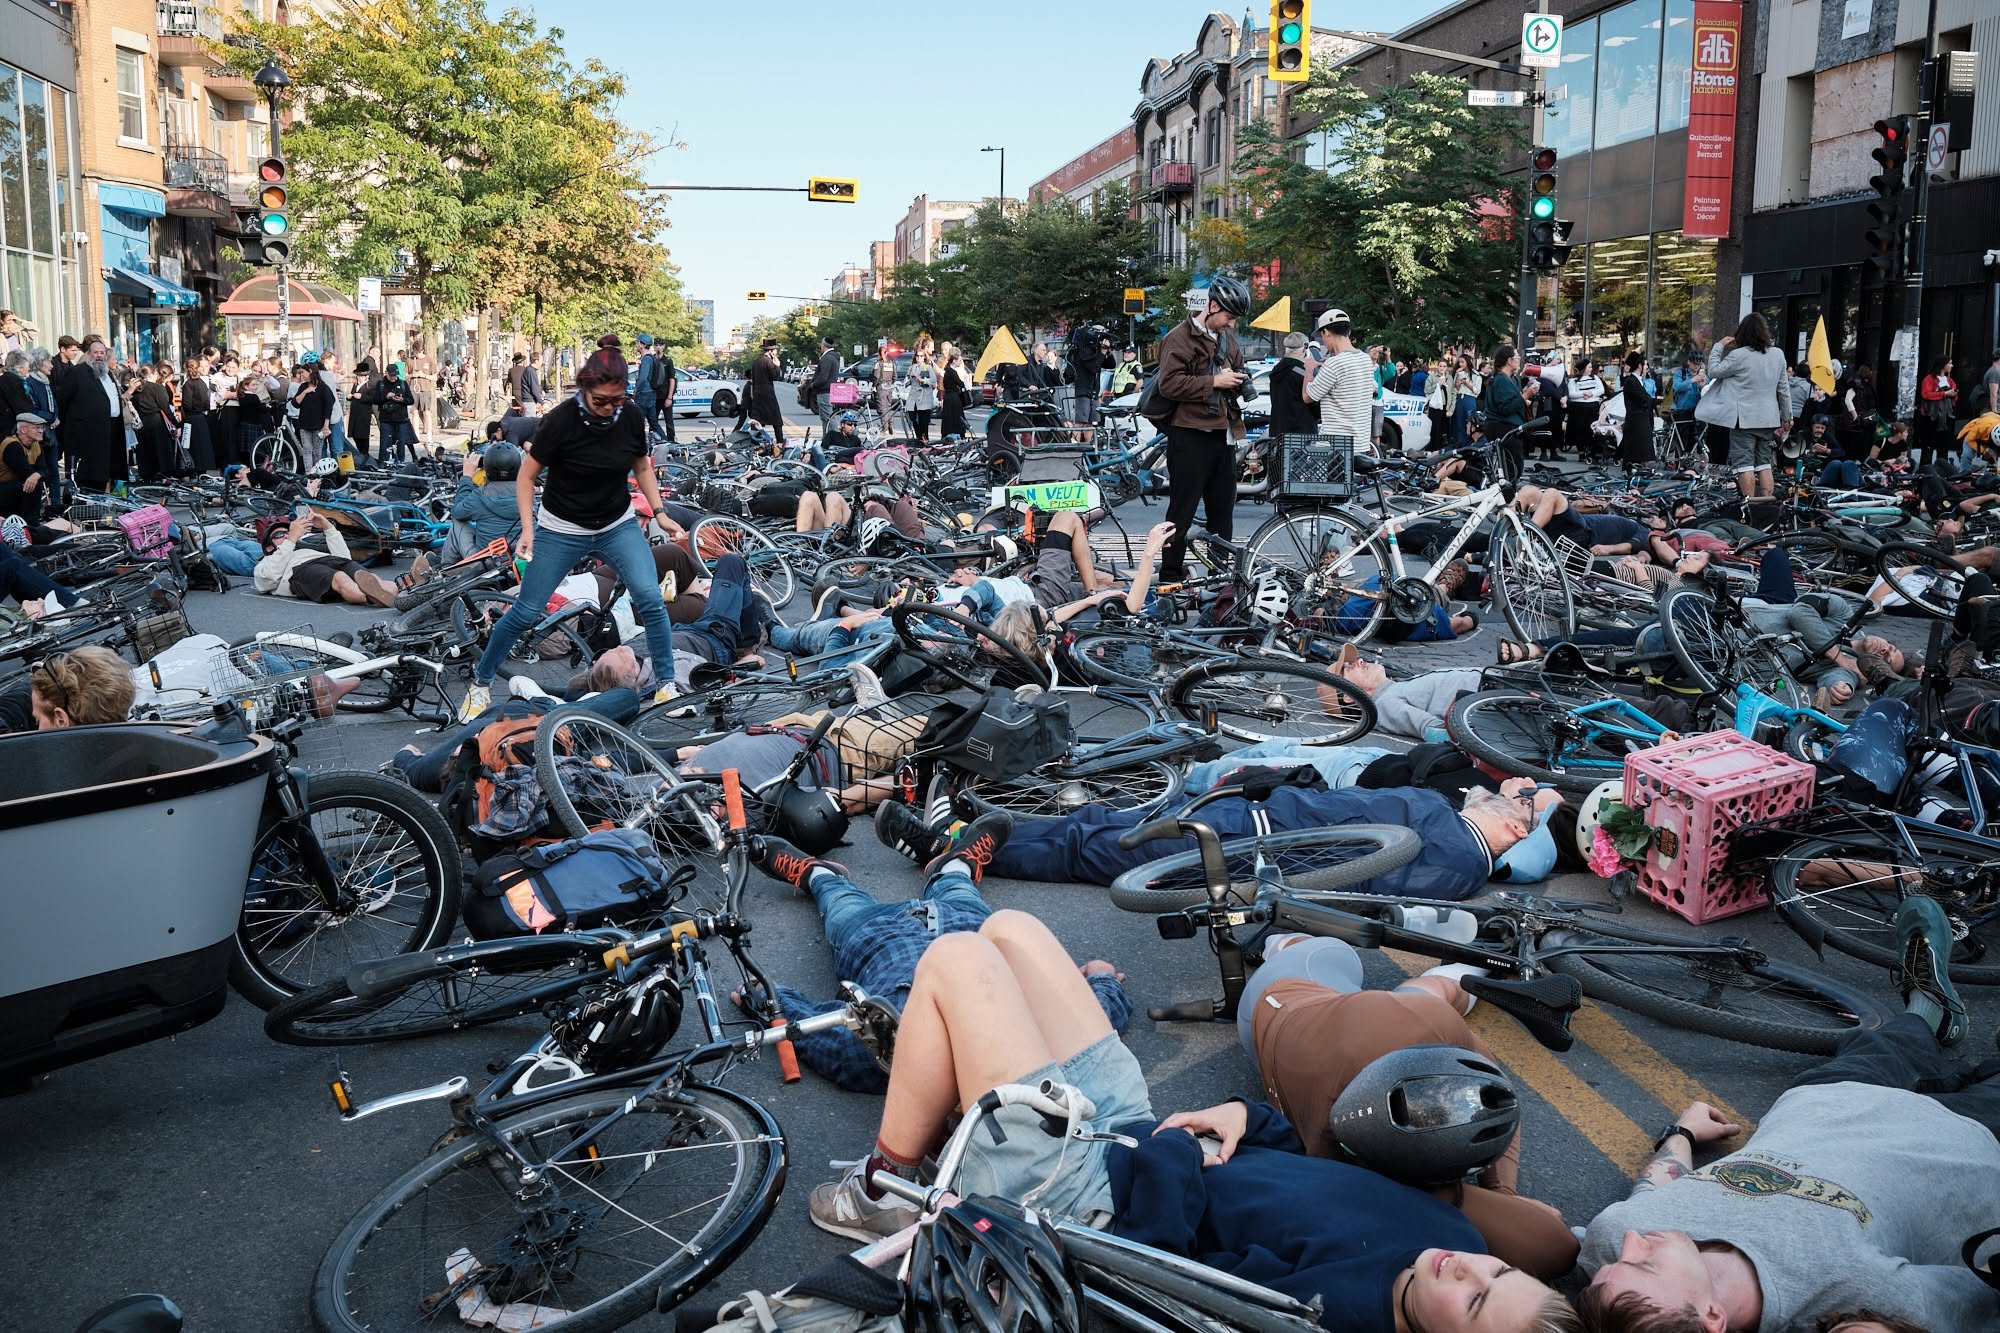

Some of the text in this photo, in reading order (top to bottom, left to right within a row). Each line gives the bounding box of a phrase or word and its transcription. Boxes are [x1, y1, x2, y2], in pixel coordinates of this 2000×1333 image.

[1693, 71, 1735, 86] Home
[1693, 85, 1734, 95] hardware
[1472, 95, 1505, 103] Bernard
[1689, 134, 1732, 142] Quincaillerie
[1045, 485, 1084, 500] VEUT
[1487, 958, 1511, 968] DIVERGE
